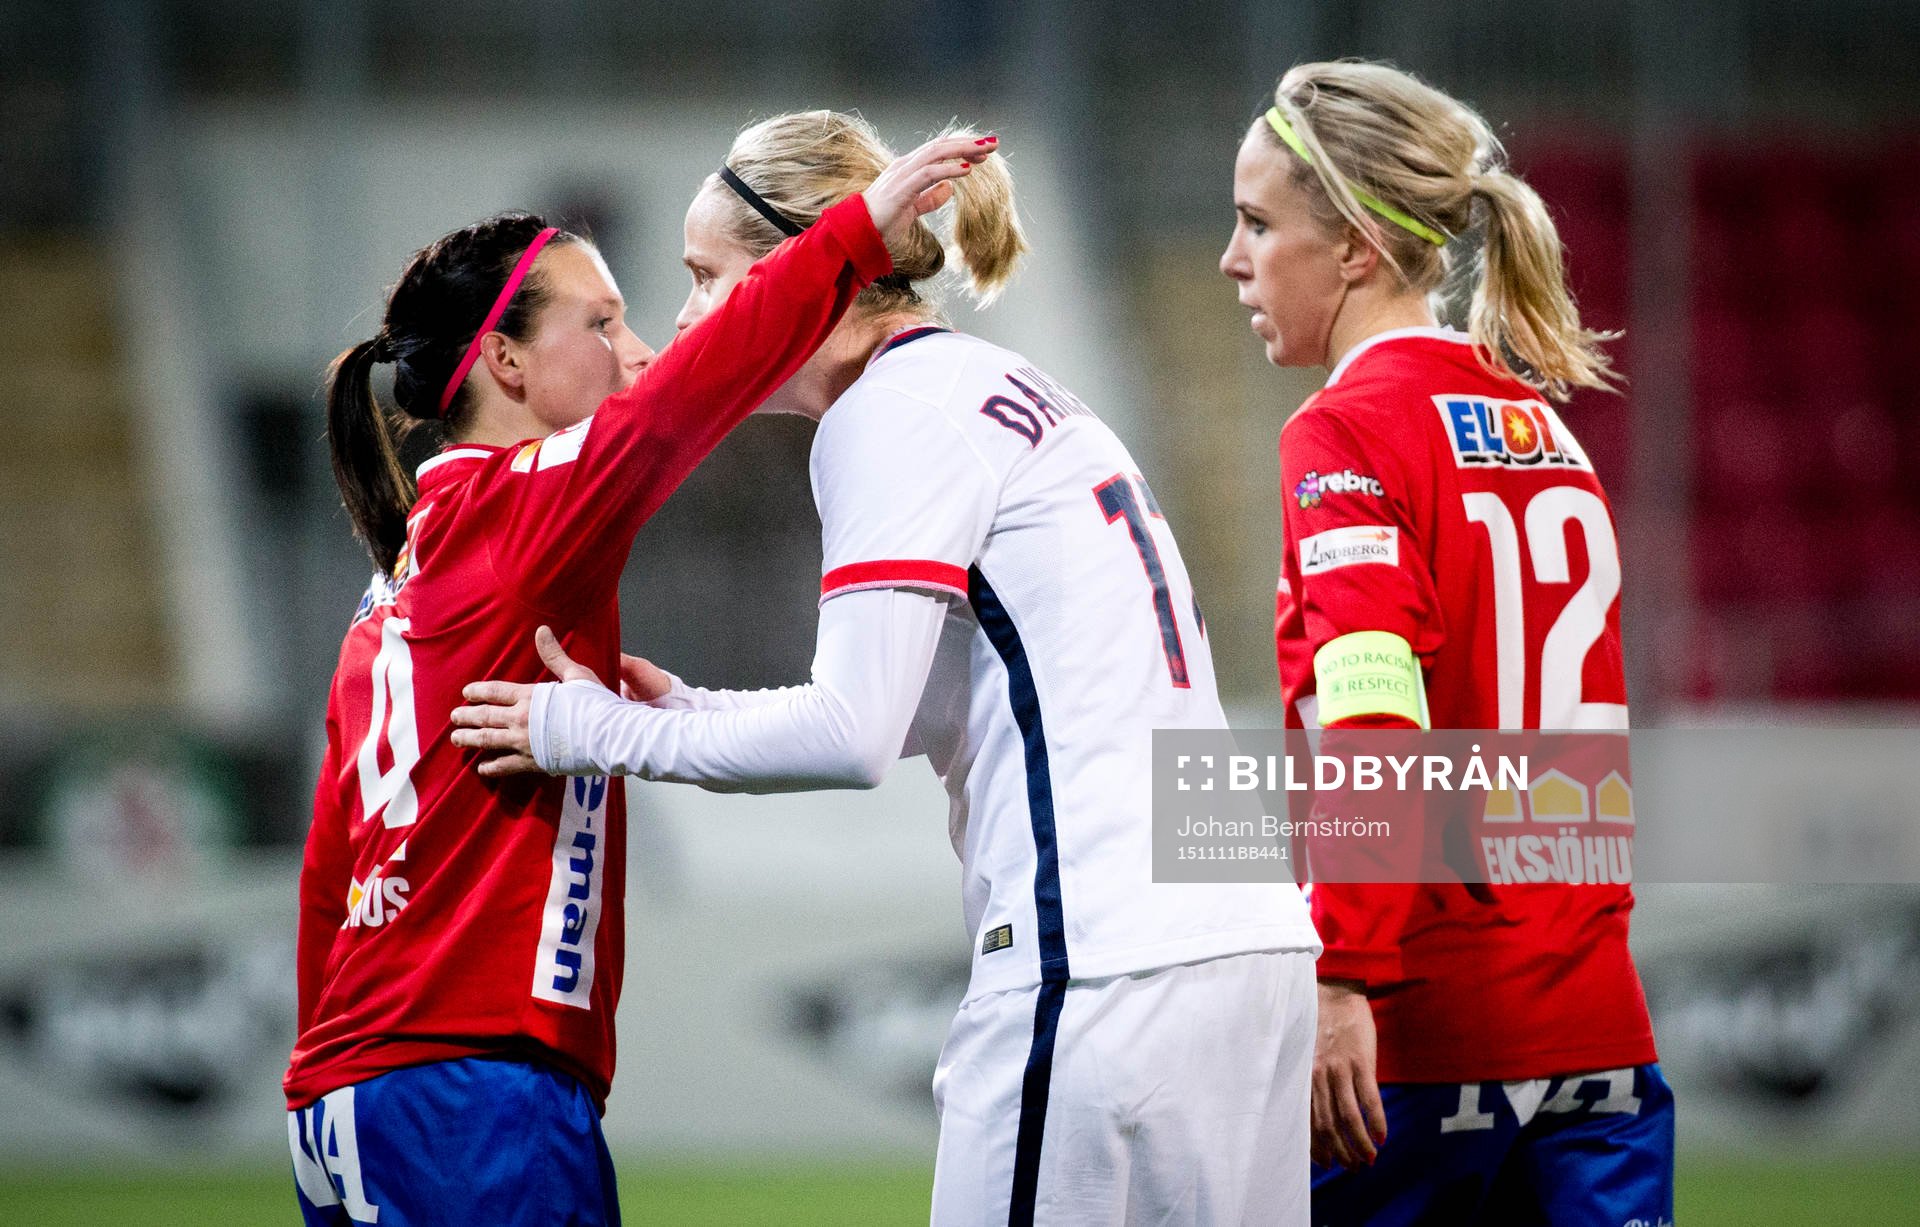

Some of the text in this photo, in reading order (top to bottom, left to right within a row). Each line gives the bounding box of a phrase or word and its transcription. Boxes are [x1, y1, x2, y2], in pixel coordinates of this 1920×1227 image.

[1461, 485, 1630, 736] 12
[358, 616, 421, 830] 4
[1347, 677, 1409, 696] RESPECT
[1480, 827, 1635, 885] EKSJÖHU
